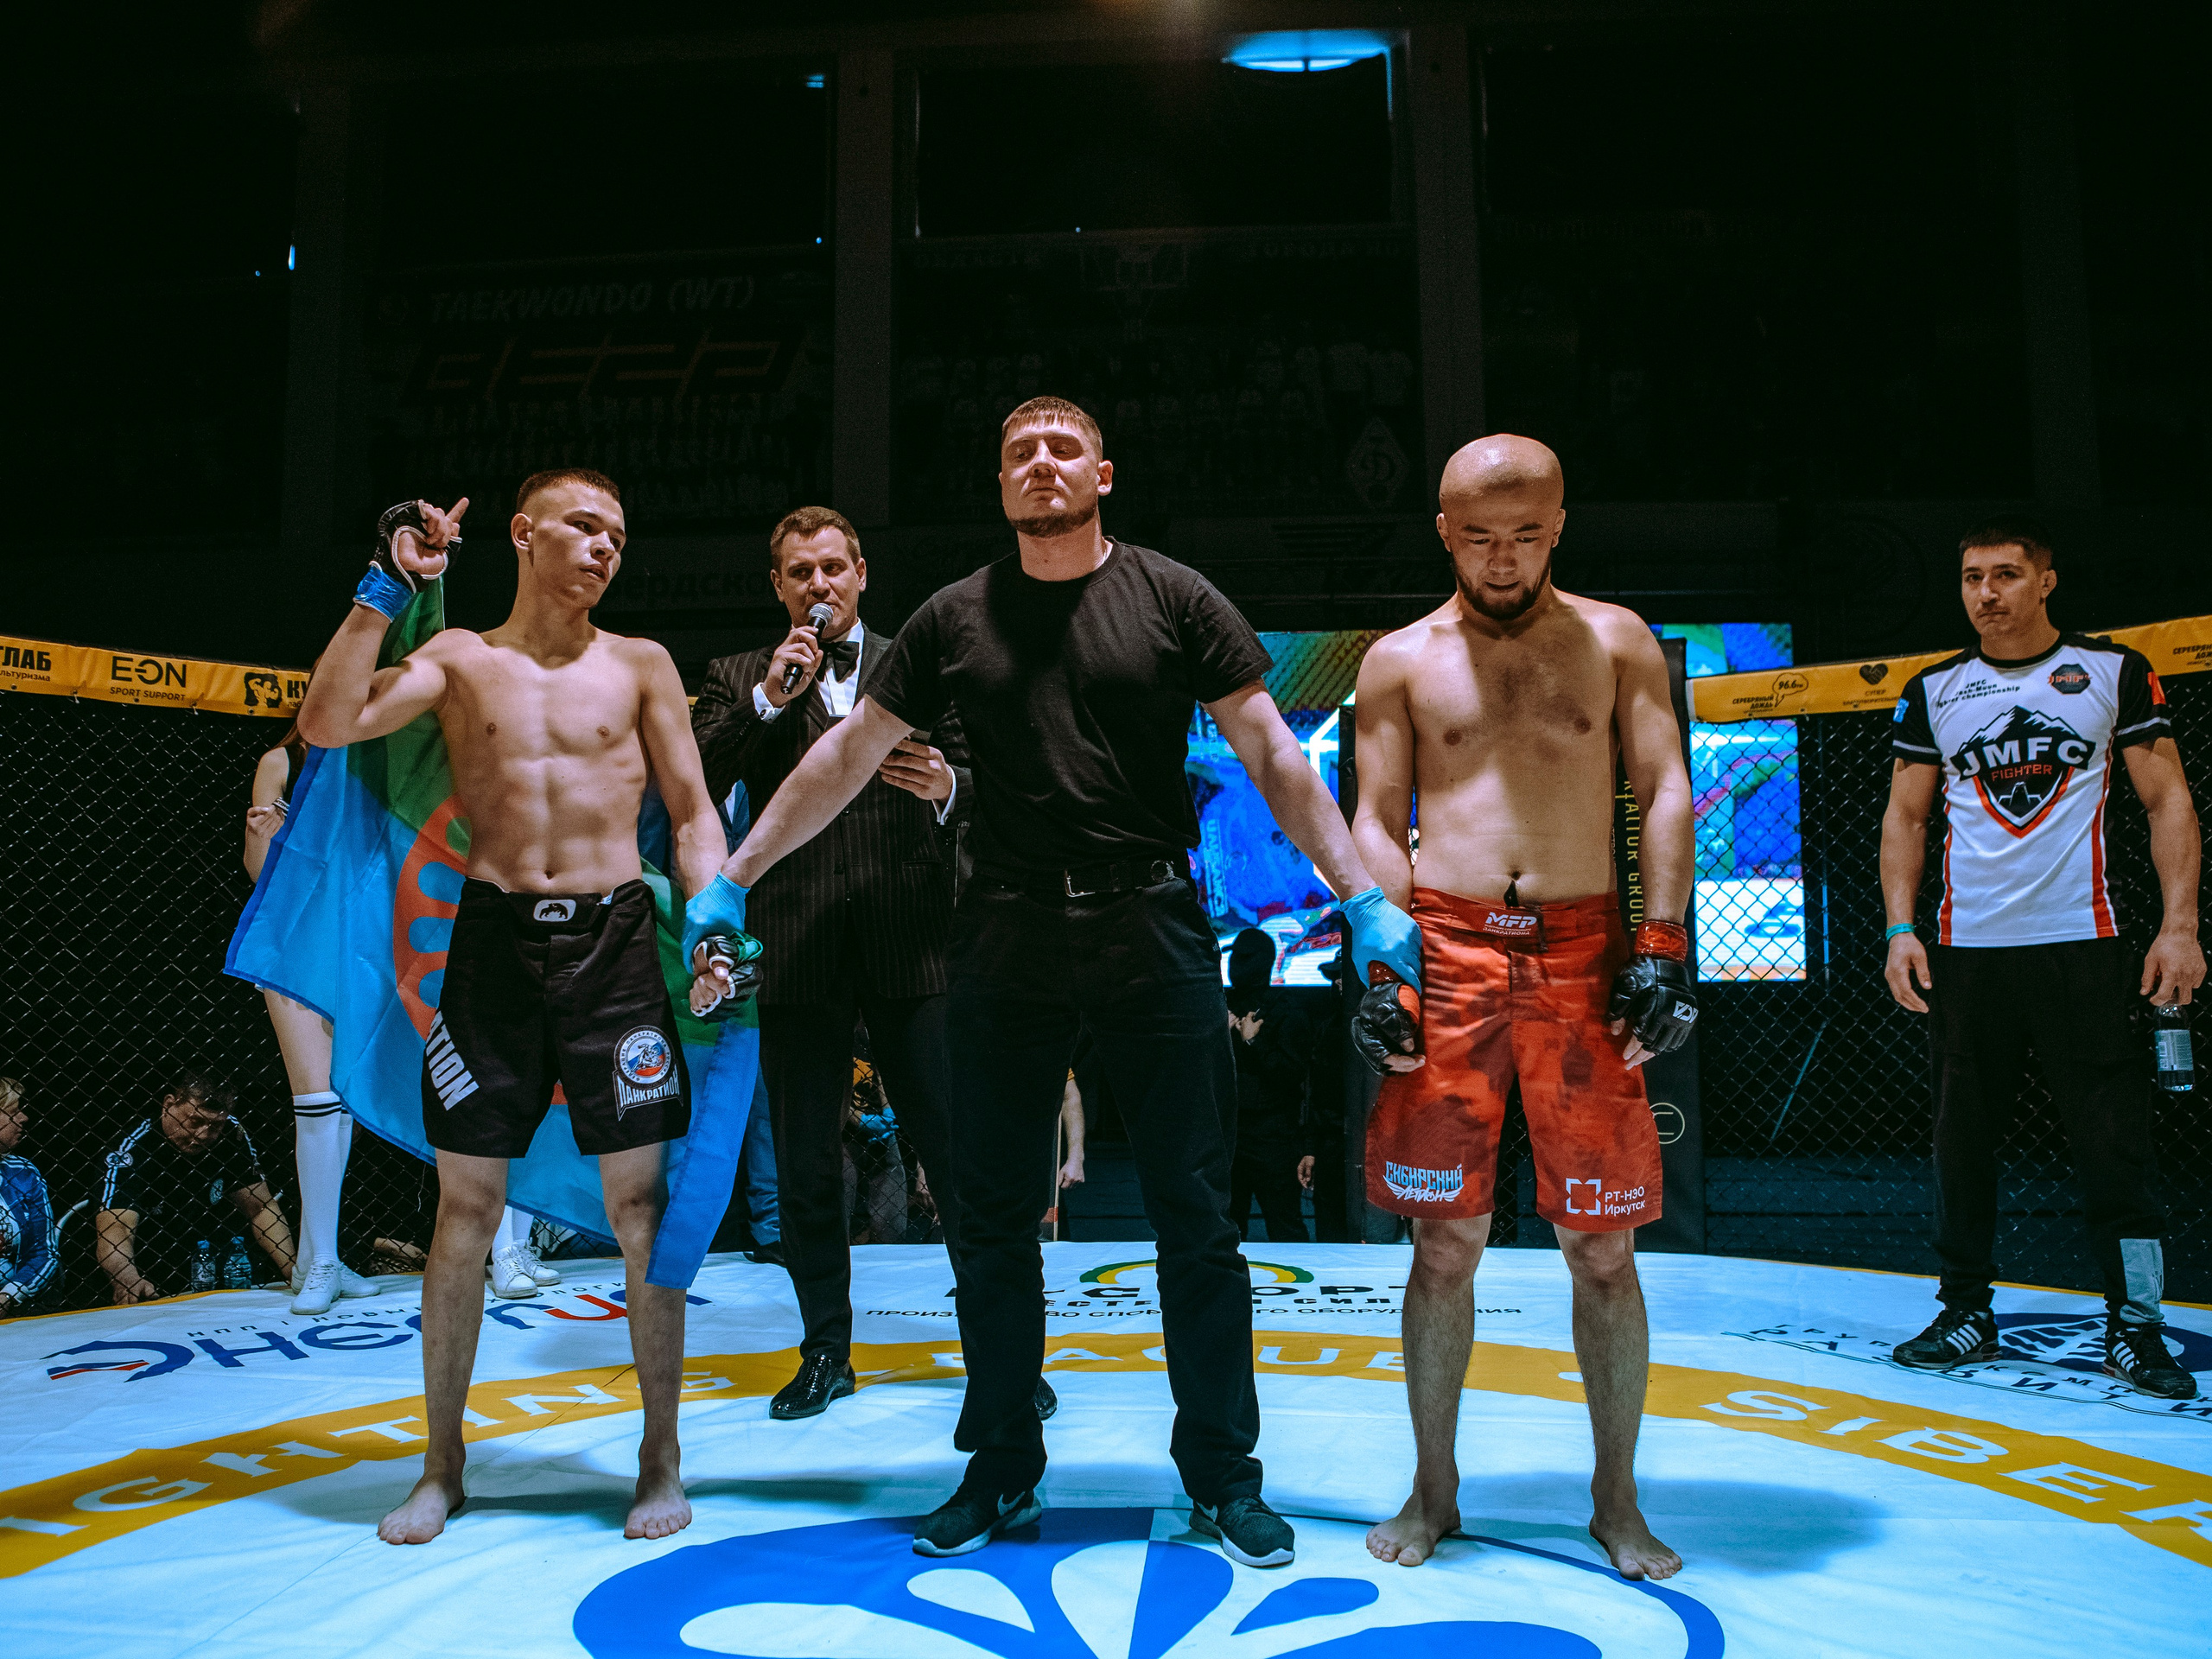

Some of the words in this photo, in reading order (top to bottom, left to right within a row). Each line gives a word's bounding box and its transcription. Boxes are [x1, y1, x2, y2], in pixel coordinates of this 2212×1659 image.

[431, 280, 653, 323] TAEKWONDO
[668, 276, 755, 313] (WT)
[110, 686, 140, 696] SPORT
[143, 690, 186, 702] SUPPORT
[1962, 736, 2088, 777] JMFC
[1991, 764, 2053, 782] FIGHTER
[1485, 912, 1537, 929] MFP
[616, 1063, 681, 1109] ПАНКРАТИОН
[1385, 1160, 1463, 1191] СИБИРСКИЙ
[1605, 1185, 1645, 1203] РТ-НЭО
[1605, 1199, 1646, 1217] Иркутск
